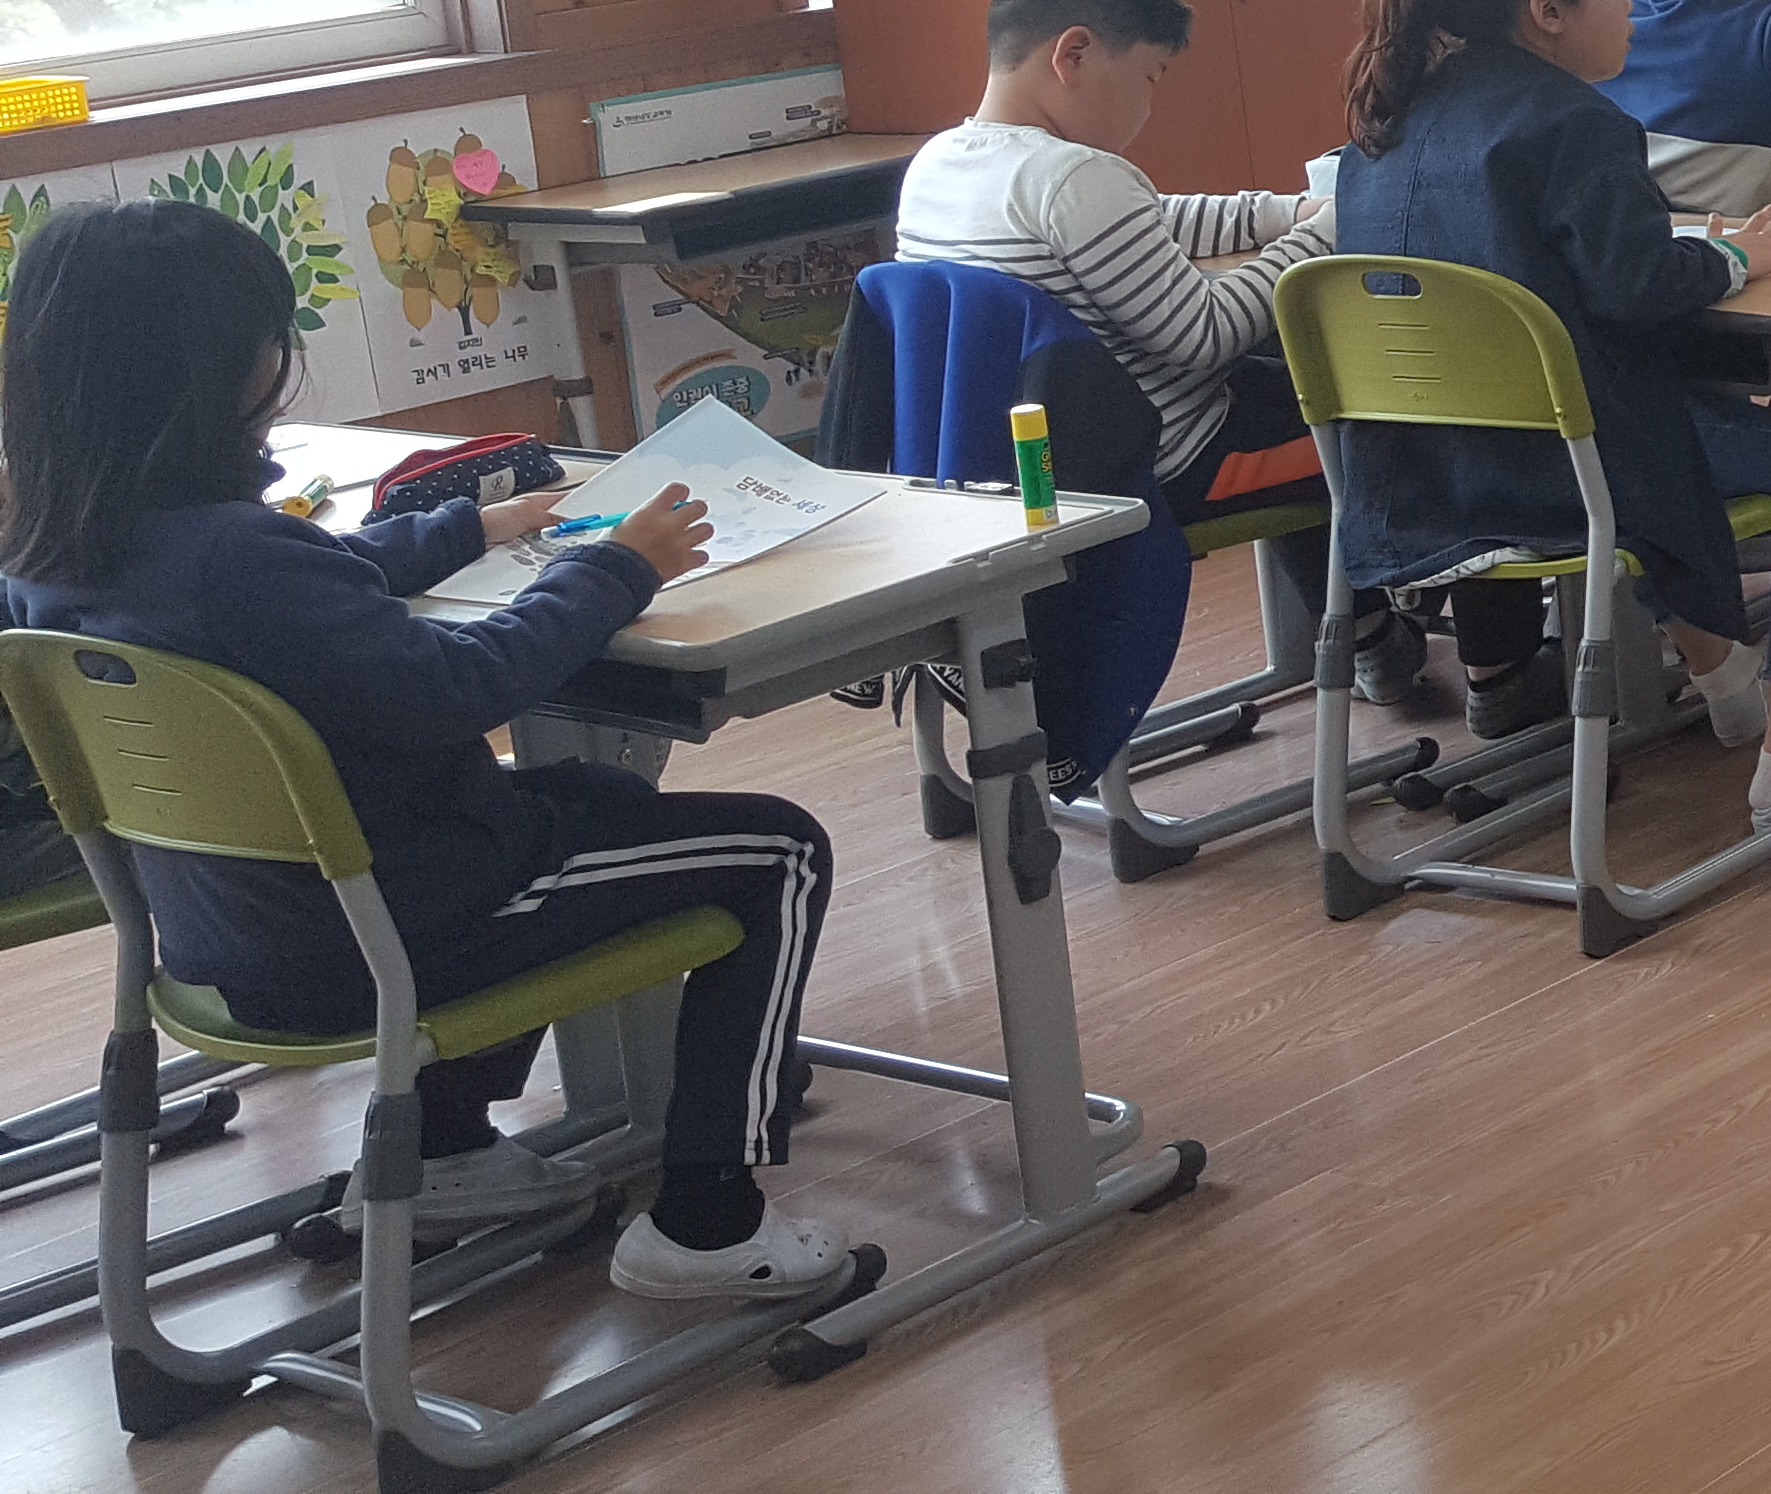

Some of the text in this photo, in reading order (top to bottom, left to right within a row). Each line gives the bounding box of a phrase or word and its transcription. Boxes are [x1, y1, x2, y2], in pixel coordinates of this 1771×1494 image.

[458, 354, 497, 375] 열리는
[504, 345, 529, 362] 나무
[721, 376, 750, 398] 존중
